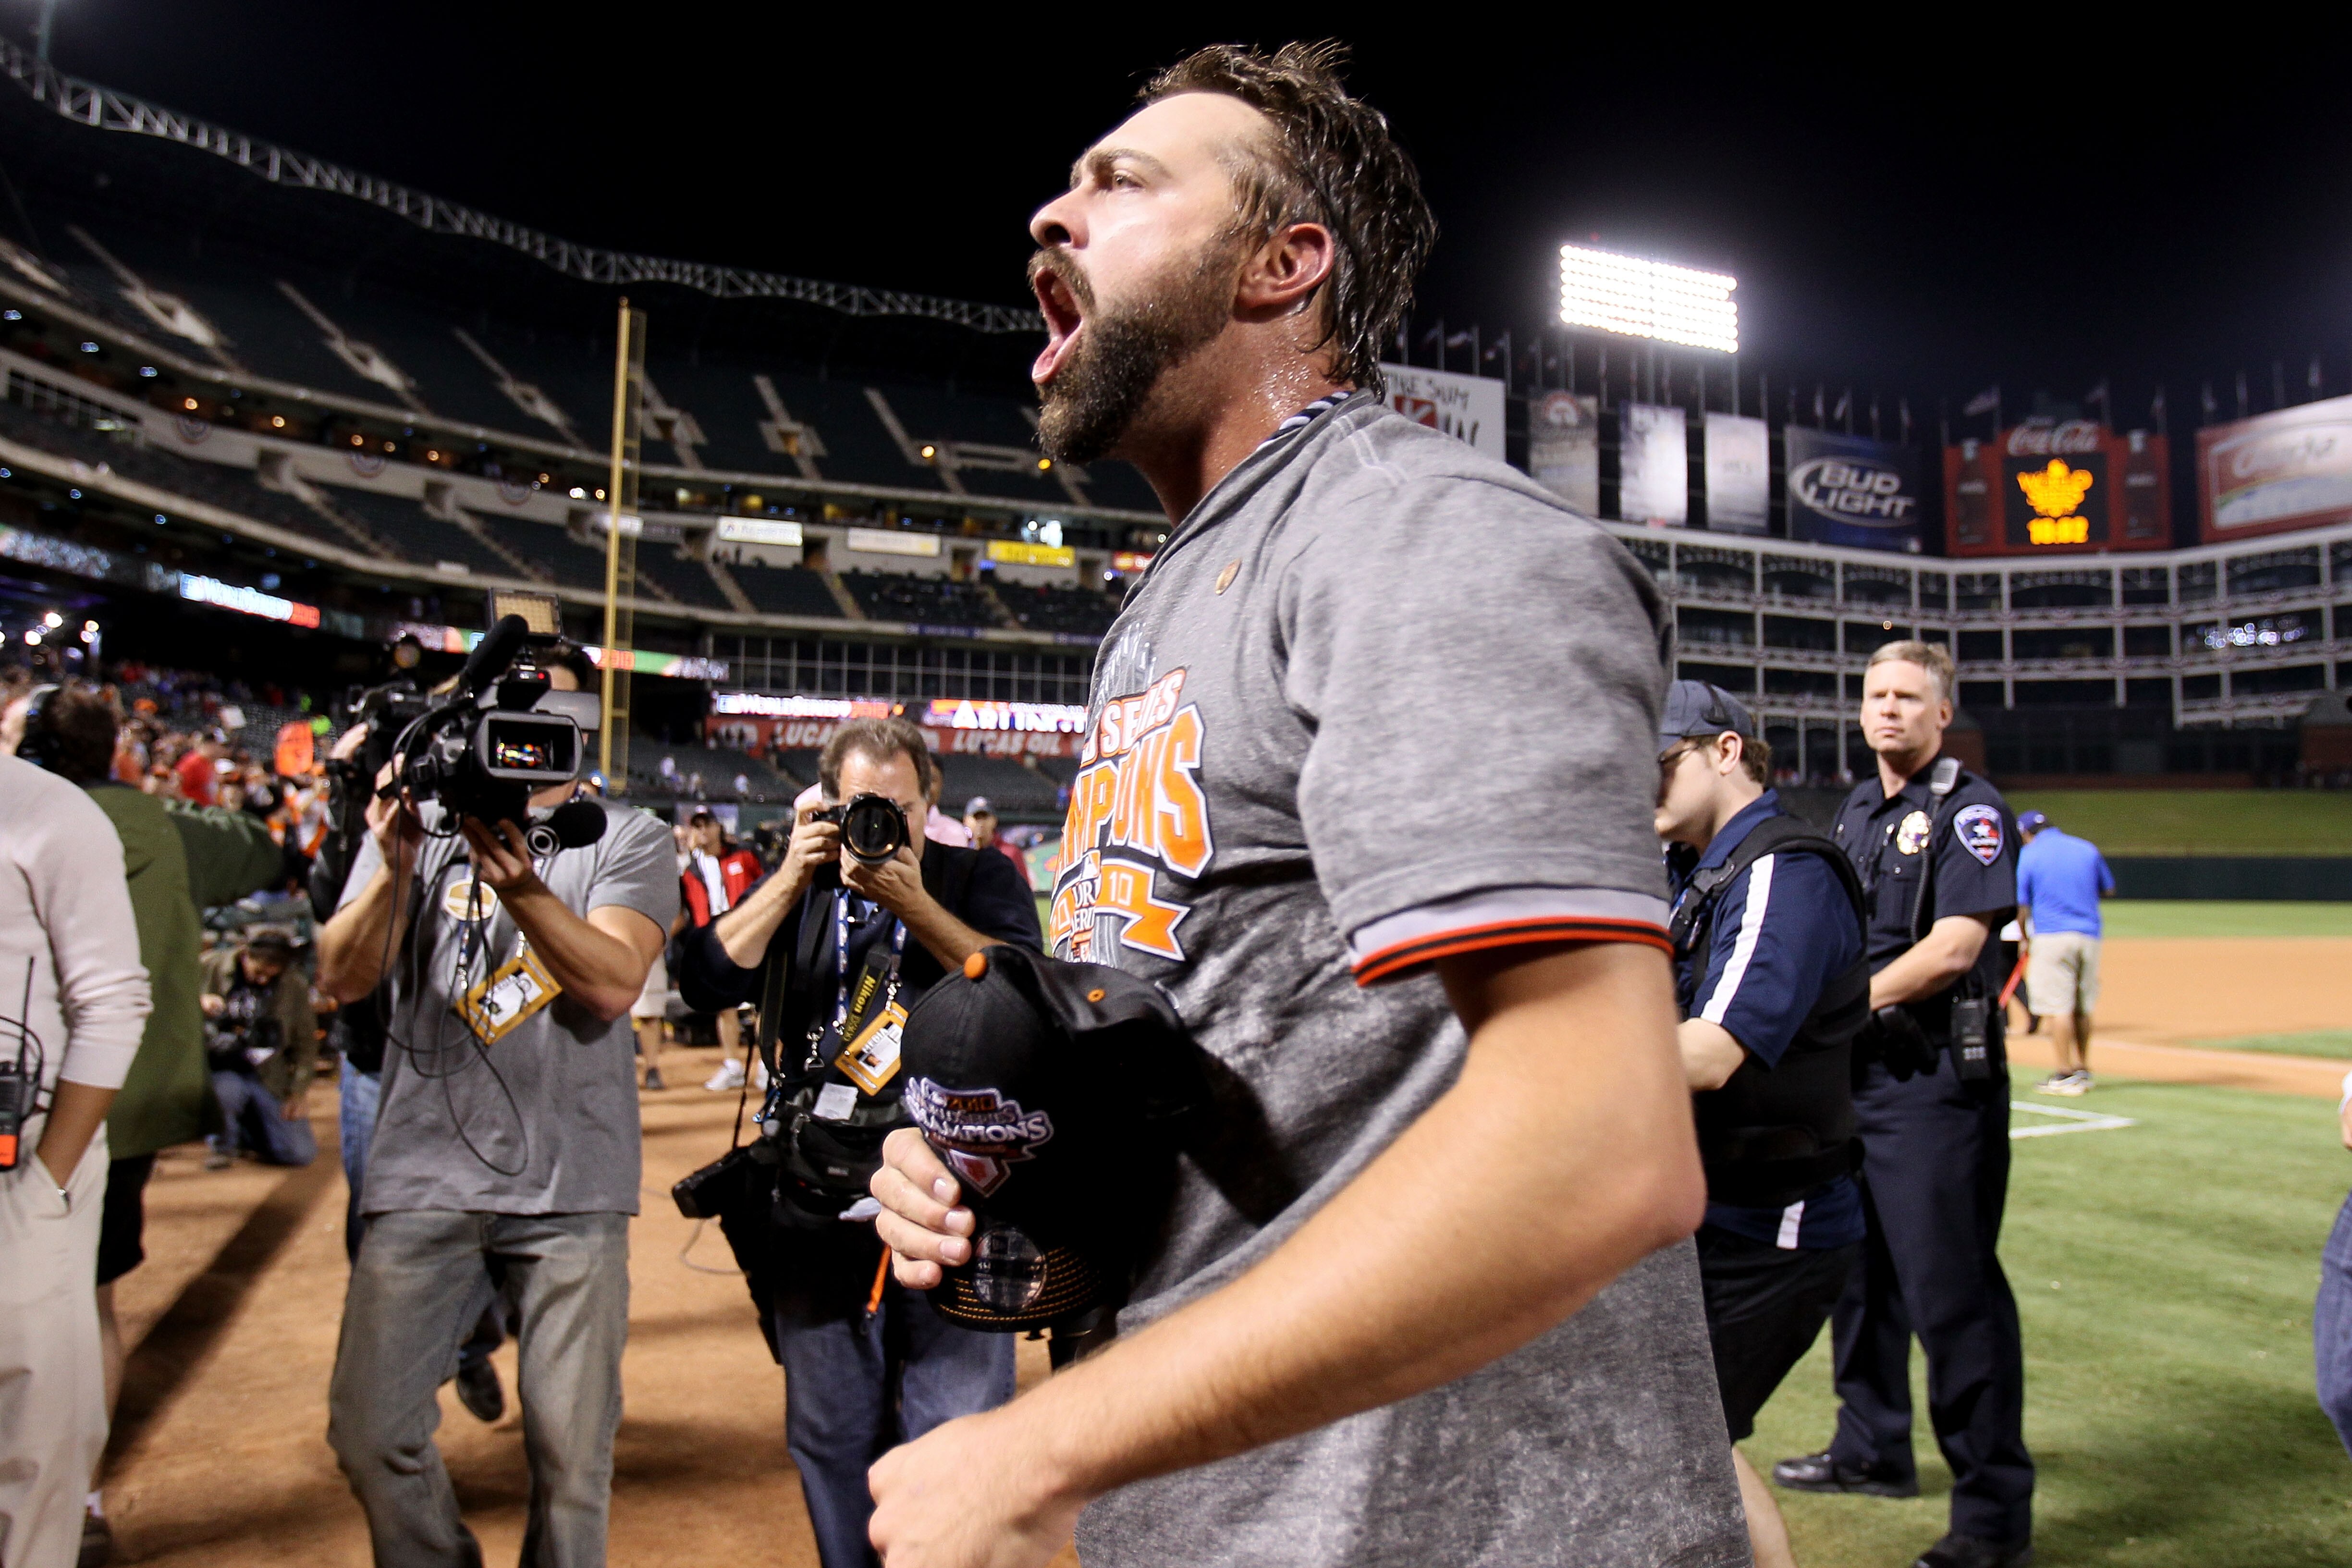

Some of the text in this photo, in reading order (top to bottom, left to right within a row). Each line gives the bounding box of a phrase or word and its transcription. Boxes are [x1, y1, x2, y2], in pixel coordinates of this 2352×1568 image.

[1819, 462, 1901, 495] BUD
[1804, 481, 1916, 519] LIGHT
[773, 722, 834, 747] LUCA
[1109, 870, 1134, 907] 10
[854, 974, 877, 1015] Nikon
[862, 1027, 889, 1054] MEDIA
